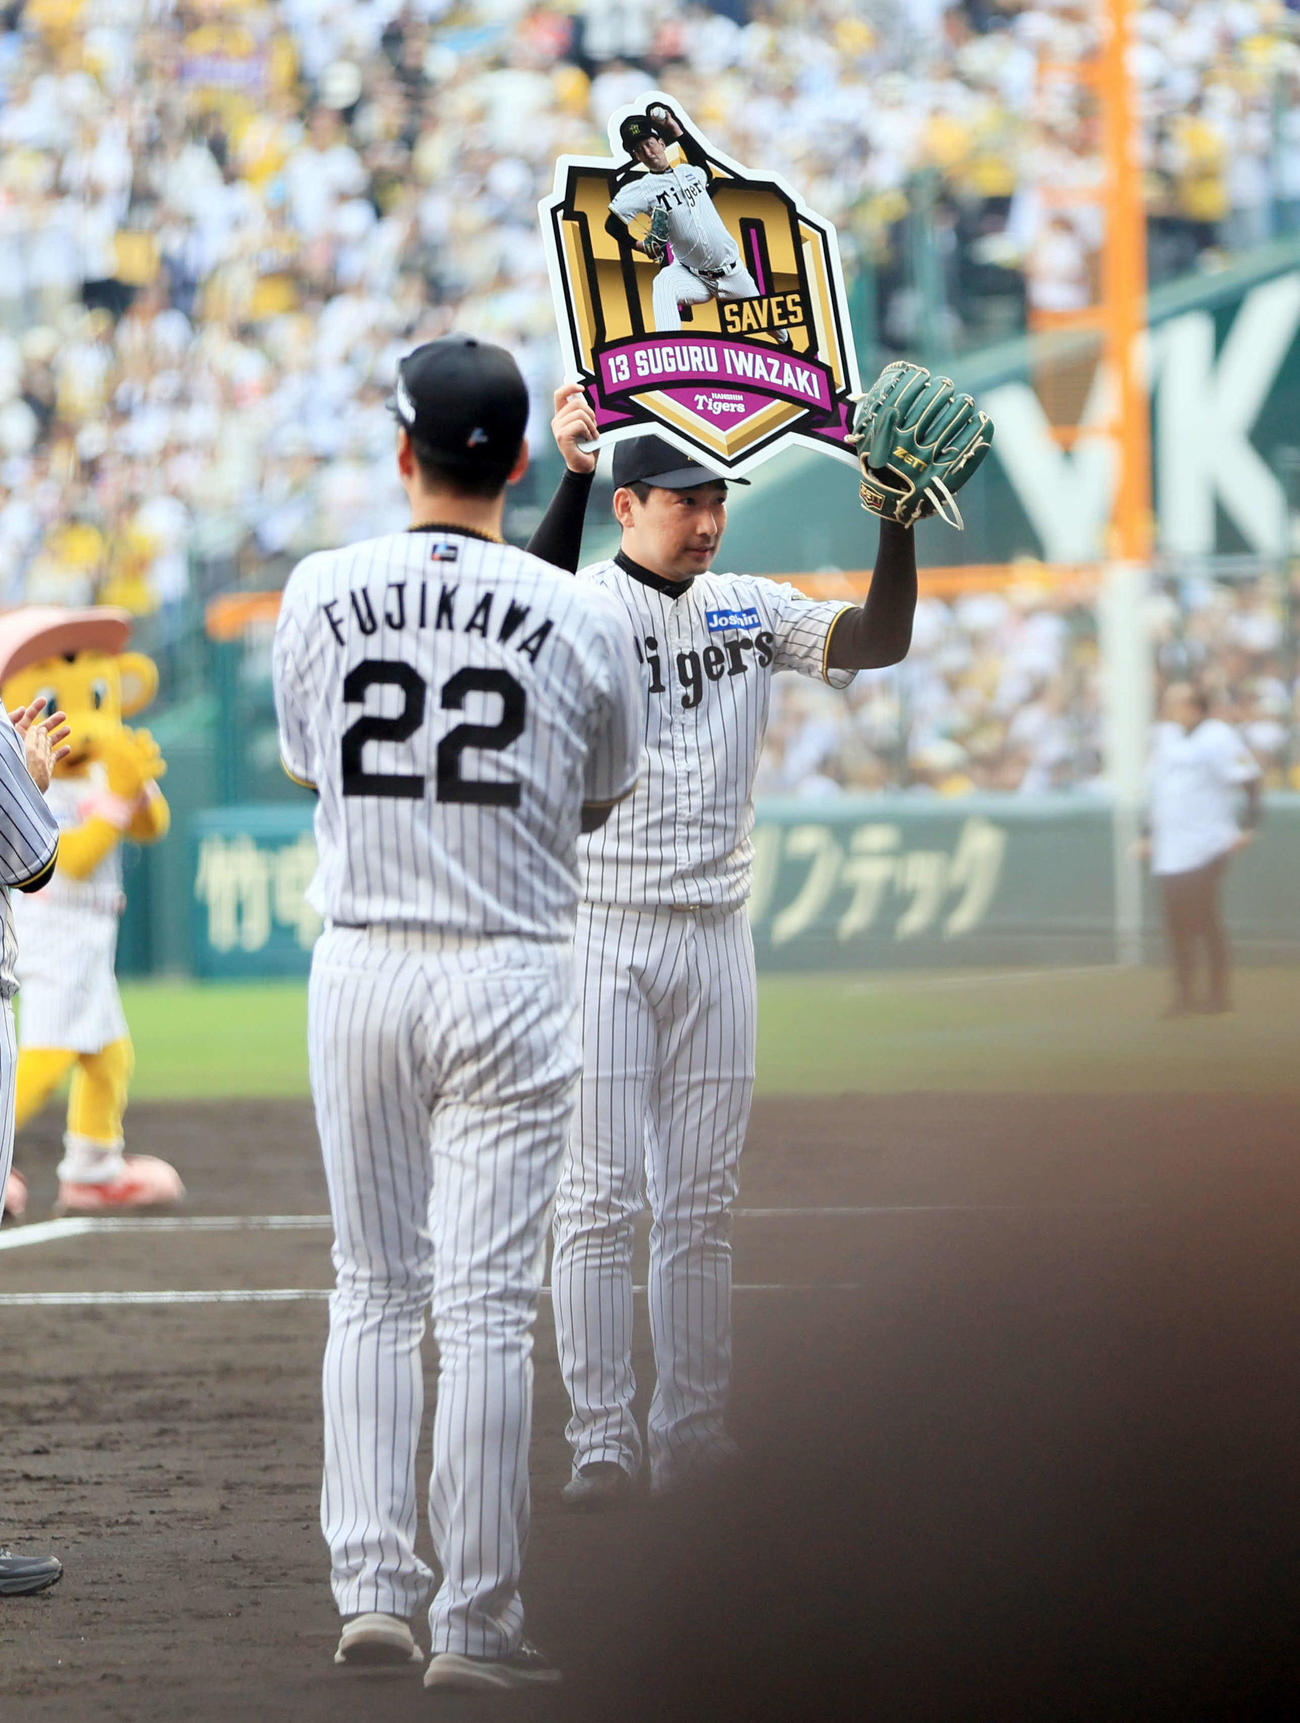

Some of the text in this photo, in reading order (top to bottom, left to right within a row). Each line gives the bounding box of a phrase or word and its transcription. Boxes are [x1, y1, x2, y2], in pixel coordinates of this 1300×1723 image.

[723, 294, 804, 333] SAVES
[608, 345, 821, 400] 13 SUGURU IWAZAKI
[693, 394, 746, 415] Tigers
[323, 580, 554, 664] FUJIKAWA
[708, 612, 759, 628] Joshin
[634, 631, 774, 709] igers
[341, 659, 527, 808] 22
